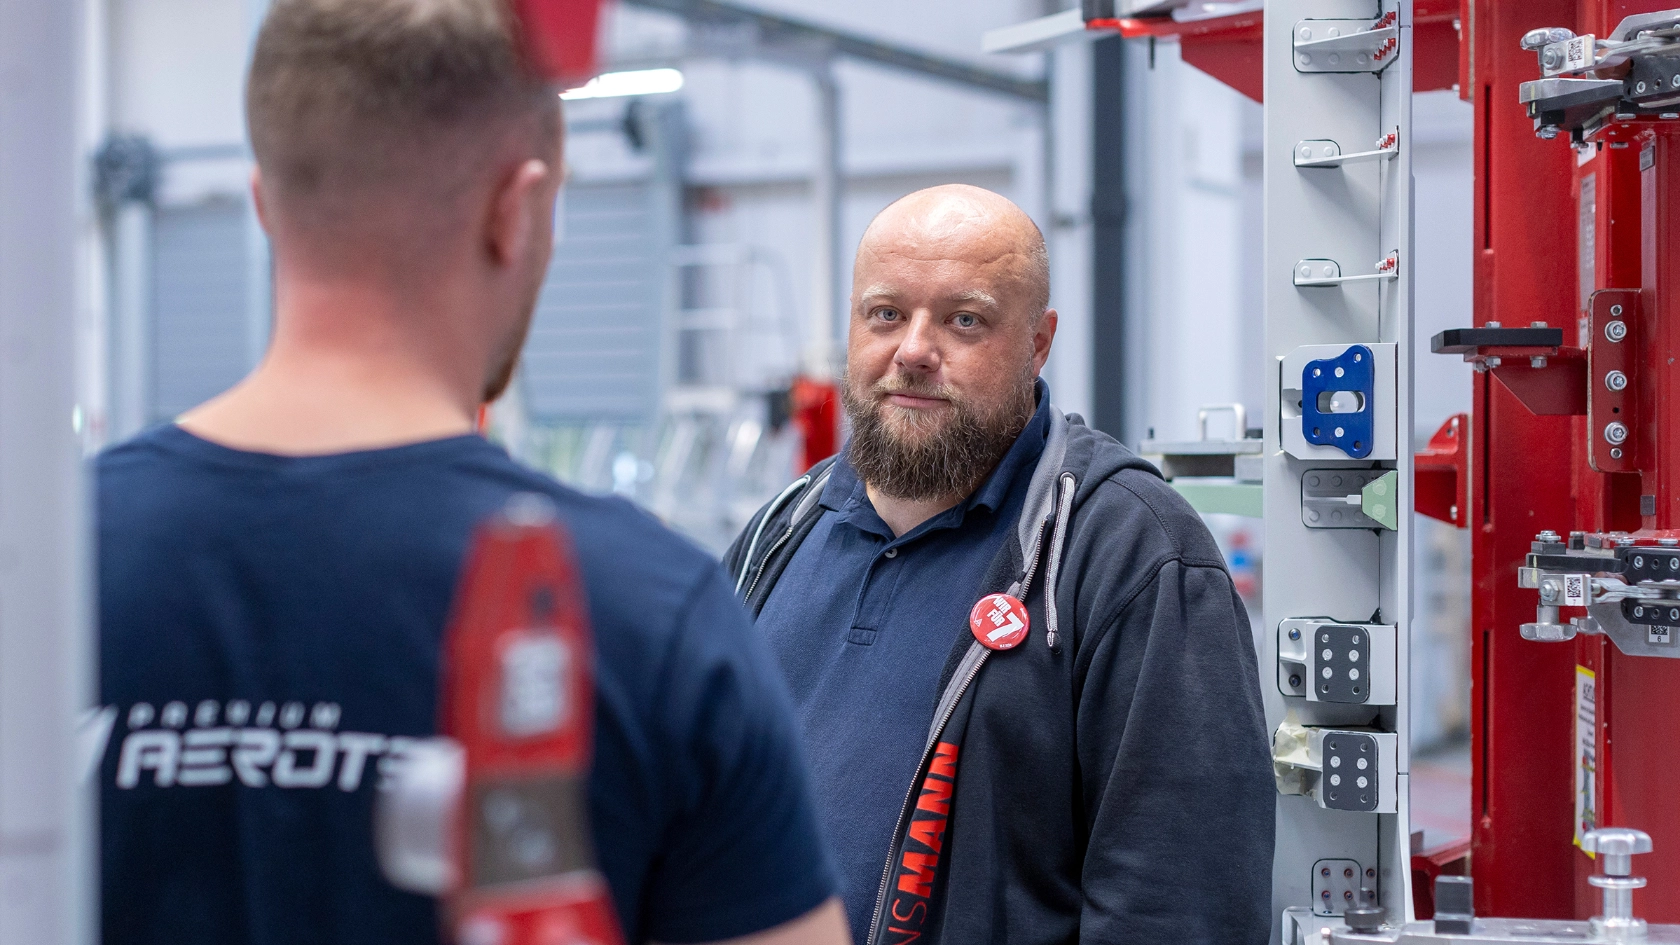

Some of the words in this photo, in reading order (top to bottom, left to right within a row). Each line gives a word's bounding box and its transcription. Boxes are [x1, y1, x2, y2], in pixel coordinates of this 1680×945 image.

[993, 596, 1011, 614] WIR
[986, 608, 1005, 627] FÜR
[986, 611, 1025, 643] 7
[1656, 635, 1662, 643] 6
